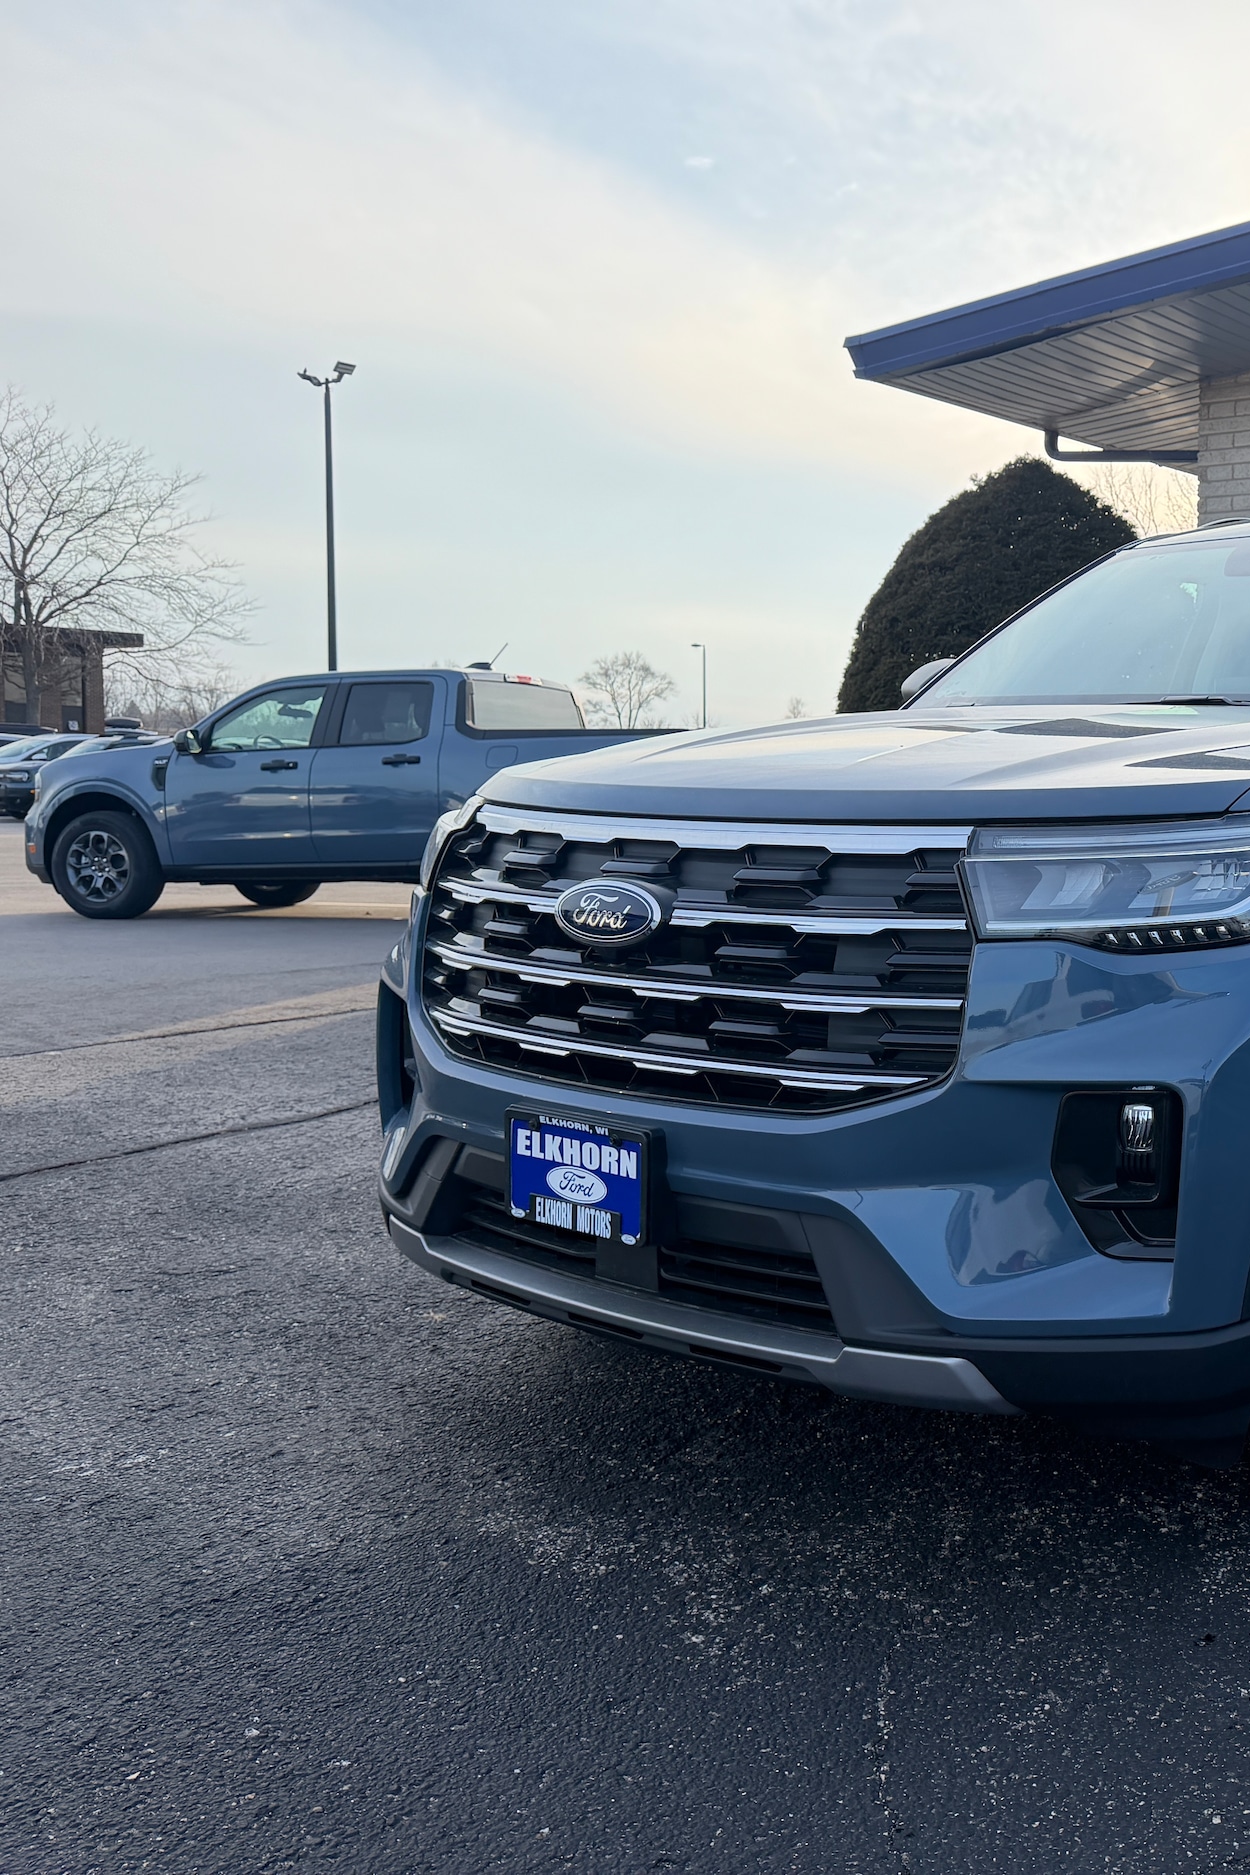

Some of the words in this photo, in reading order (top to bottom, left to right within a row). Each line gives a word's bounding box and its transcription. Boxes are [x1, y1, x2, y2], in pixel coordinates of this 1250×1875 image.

[573, 893, 632, 929] Ford
[539, 1115, 593, 1134] ELKHORN,
[595, 1127, 609, 1136] WI
[517, 1128, 637, 1180] ELKHORN
[559, 1171, 595, 1198] Ford
[535, 1197, 573, 1230] ELKHORN
[576, 1205, 612, 1239] MOTORS
